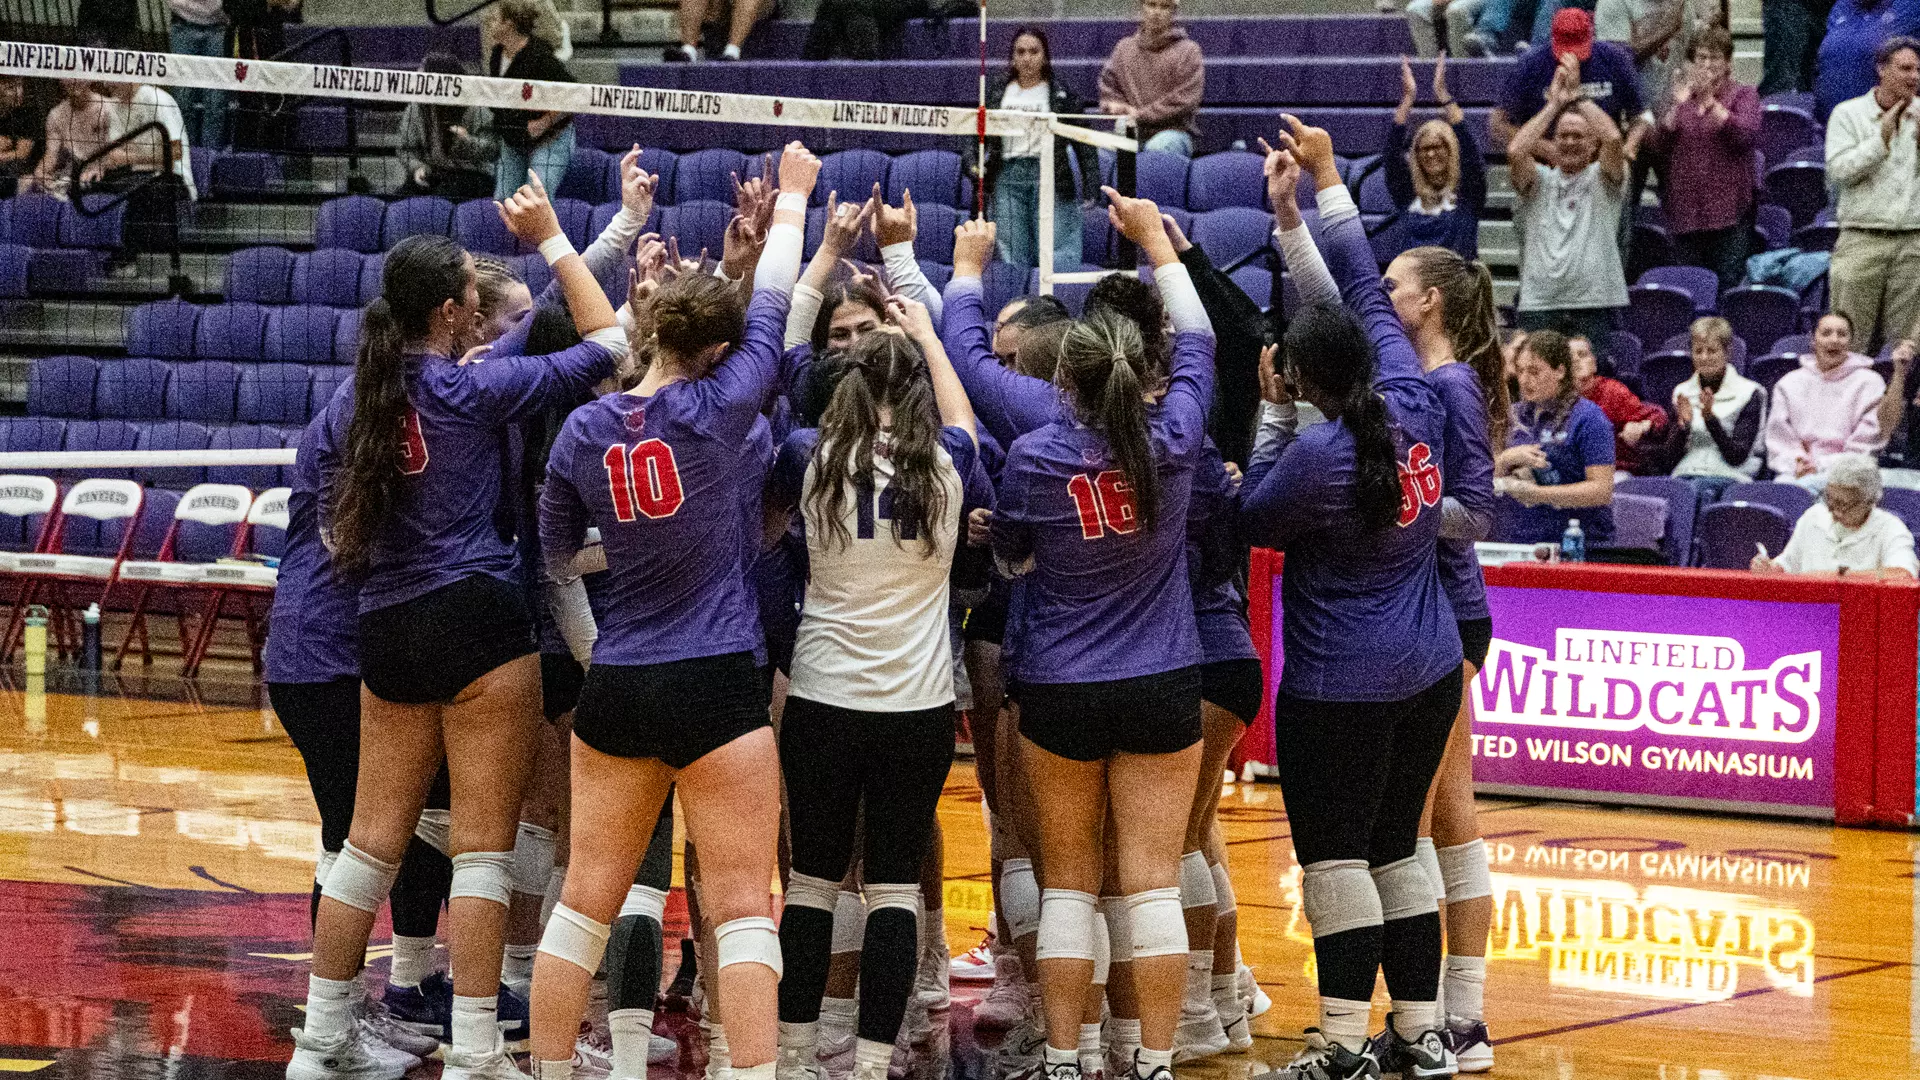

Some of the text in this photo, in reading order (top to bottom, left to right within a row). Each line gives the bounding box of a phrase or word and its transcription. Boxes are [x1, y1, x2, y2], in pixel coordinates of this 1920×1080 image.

[80, 49, 167, 78] WILDCATS
[313, 66, 463, 98] LINFIELD WILDCATS
[590, 86, 722, 115] LINFIELD WILDCATS
[833, 103, 949, 128] LINFIELD WILDCATS
[603, 437, 685, 522] 10
[1066, 469, 1142, 540] 16
[1565, 637, 1735, 671] LINFIELD
[1478, 649, 1811, 733] WILDCATS
[1471, 734, 1814, 781] TED WILSON GYMNASIUM
